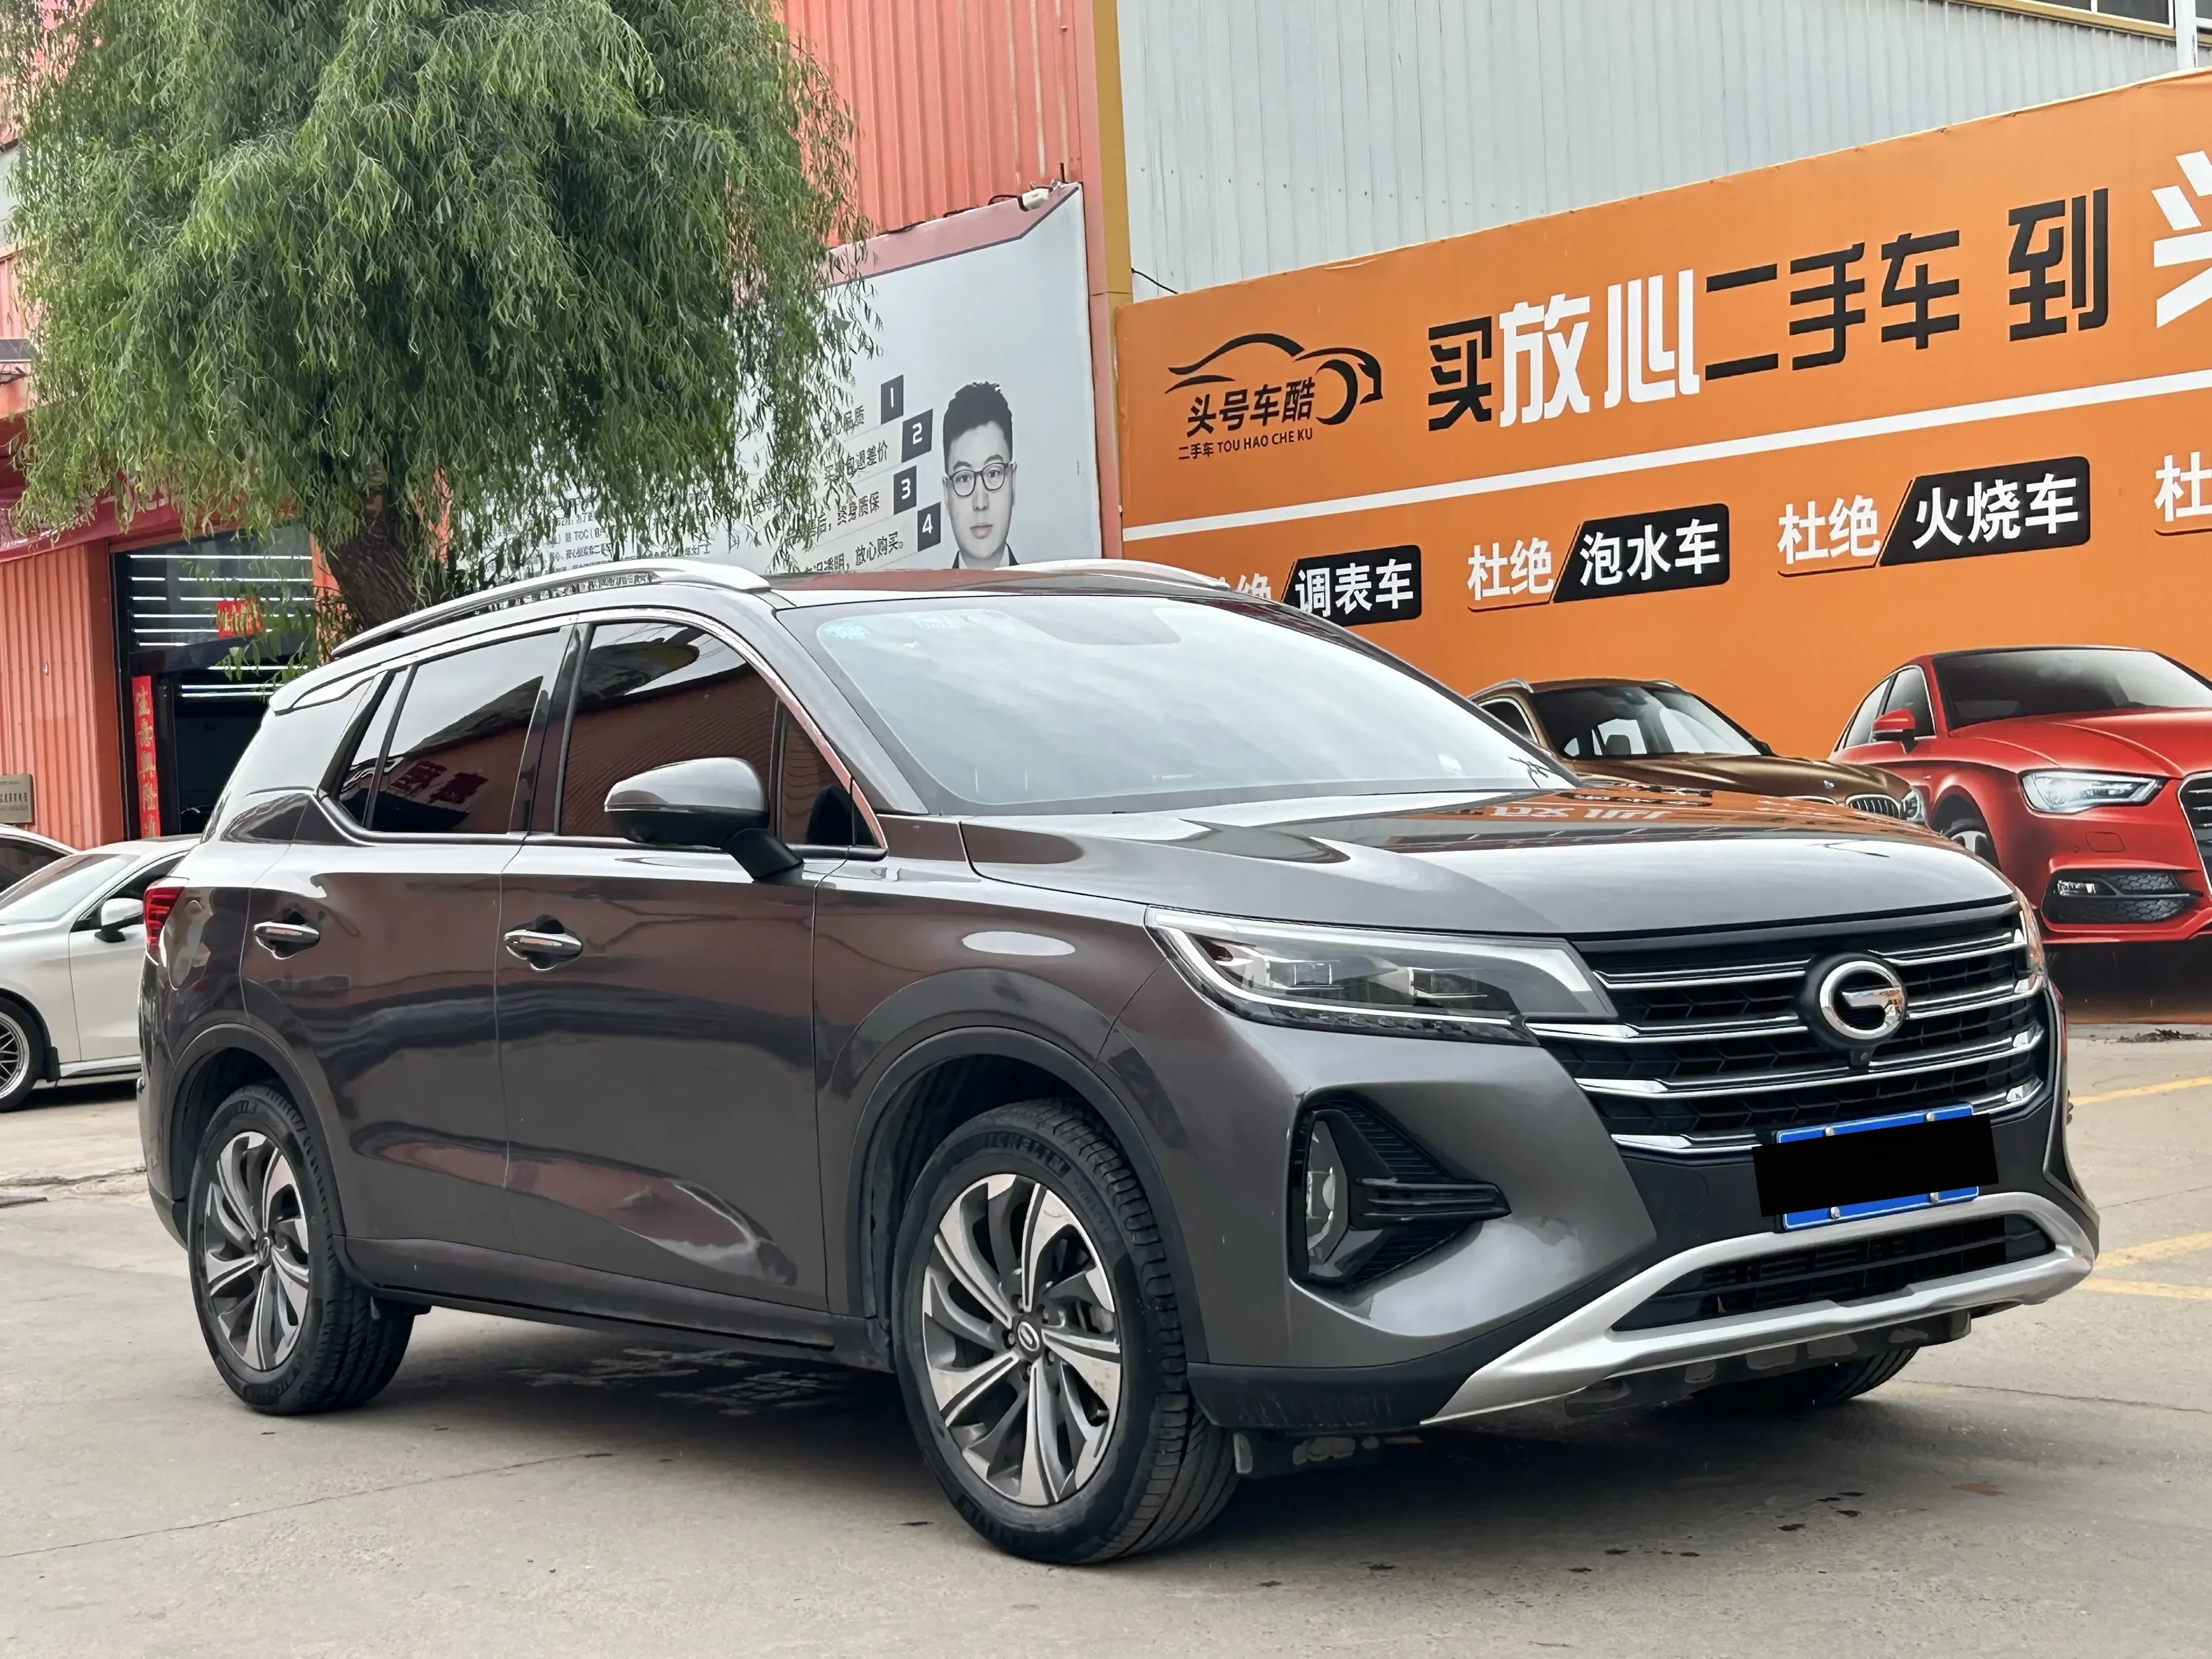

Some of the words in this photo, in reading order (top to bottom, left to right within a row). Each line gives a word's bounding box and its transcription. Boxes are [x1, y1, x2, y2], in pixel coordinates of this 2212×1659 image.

[1187, 376, 1316, 438] 头号车酷
[912, 422, 923, 445] 2
[1179, 442, 1214, 459] 二手车
[1217, 439, 1240, 452] TOU
[1244, 435, 1268, 450] HAO
[1271, 431, 1294, 445] CHE
[1297, 427, 1313, 441] KU
[901, 478, 911, 499] 3
[922, 513, 933, 534] 4
[1777, 495, 1881, 564] 杜绝
[1912, 473, 2078, 550] 火烧车
[1467, 537, 1554, 600] 杜绝
[1580, 519, 1720, 585] 泡水车
[1295, 558, 1413, 617] 调表车
